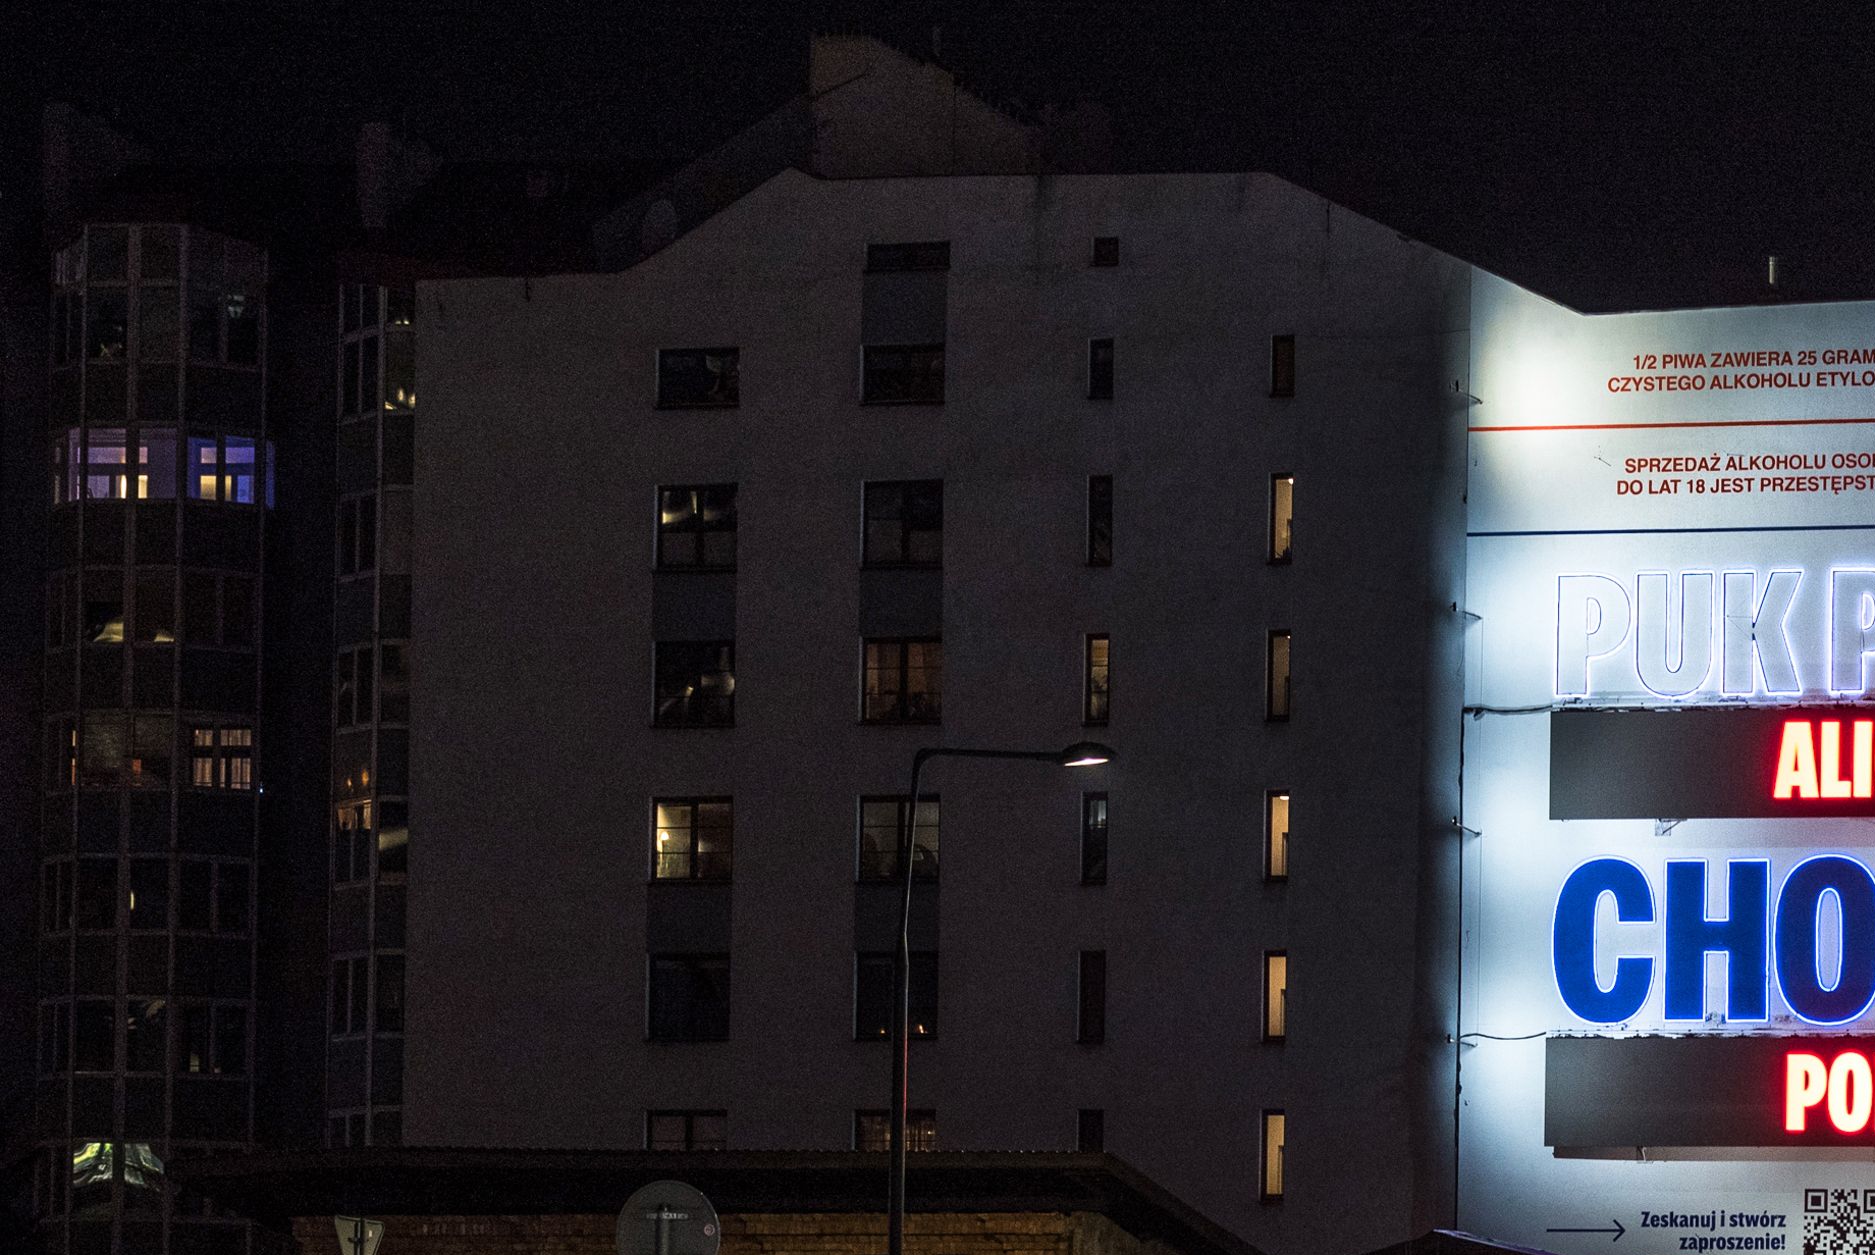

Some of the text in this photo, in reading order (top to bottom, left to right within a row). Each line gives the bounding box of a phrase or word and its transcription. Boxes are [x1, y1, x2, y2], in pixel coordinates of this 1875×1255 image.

[1633, 355, 1658, 370] 1/2
[1662, 353, 1707, 369] PIWA
[1711, 351, 1794, 368] ZAWIERA
[1797, 350, 1817, 366] 25
[1607, 375, 1706, 393] CZYSTEGO
[1710, 372, 1811, 391] ALKOHOLU
[1624, 453, 1720, 474] SPRZEDAŻ
[1725, 453, 1826, 472] ALKOHOLU
[1616, 479, 1643, 495] DO
[1648, 479, 1681, 495] LAT
[1686, 478, 1706, 494] 18
[1710, 477, 1755, 494] JEST
[1555, 567, 1803, 698] PUK
[1641, 1210, 1787, 1232] Zeskanuj i stwórz
[1679, 1233, 1786, 1253] zaproszenie!
